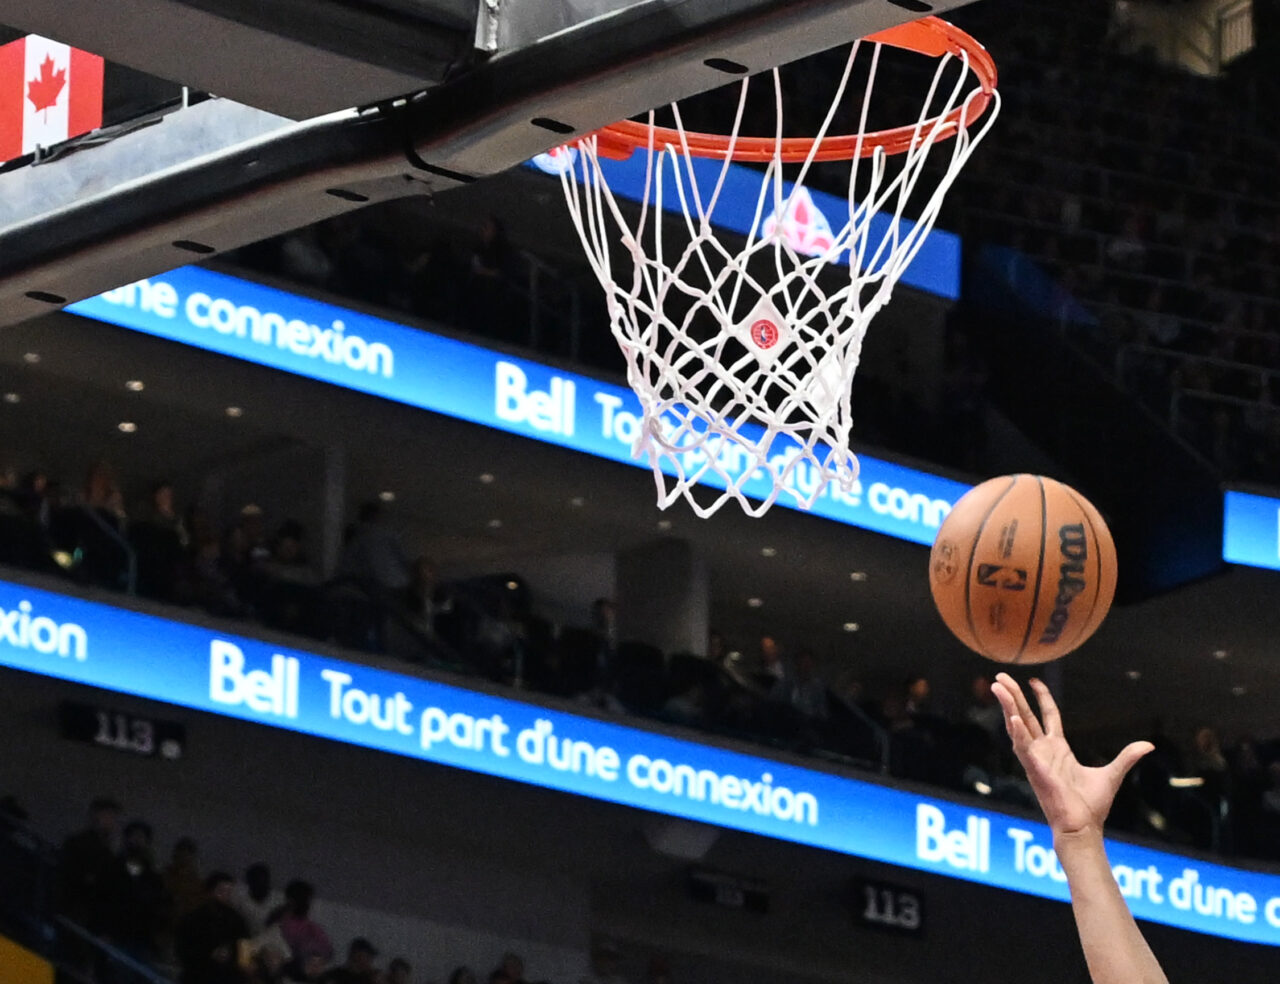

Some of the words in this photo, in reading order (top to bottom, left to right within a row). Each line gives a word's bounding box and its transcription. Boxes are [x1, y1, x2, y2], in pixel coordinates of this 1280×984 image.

[185, 290, 394, 378] connexion
[495, 360, 576, 437] Bell
[1039, 521, 1088, 645] Wilson
[94, 711, 154, 754] 113
[209, 639, 300, 719] Bell
[320, 668, 413, 736] Tout
[420, 706, 510, 757] part
[516, 718, 621, 782] d'une
[626, 754, 819, 826] connexion
[862, 884, 922, 931] 113
[915, 803, 991, 874] Bell
[1007, 827, 1064, 884] Tou
[1109, 864, 1164, 904] art
[1168, 868, 1258, 924] d'une
